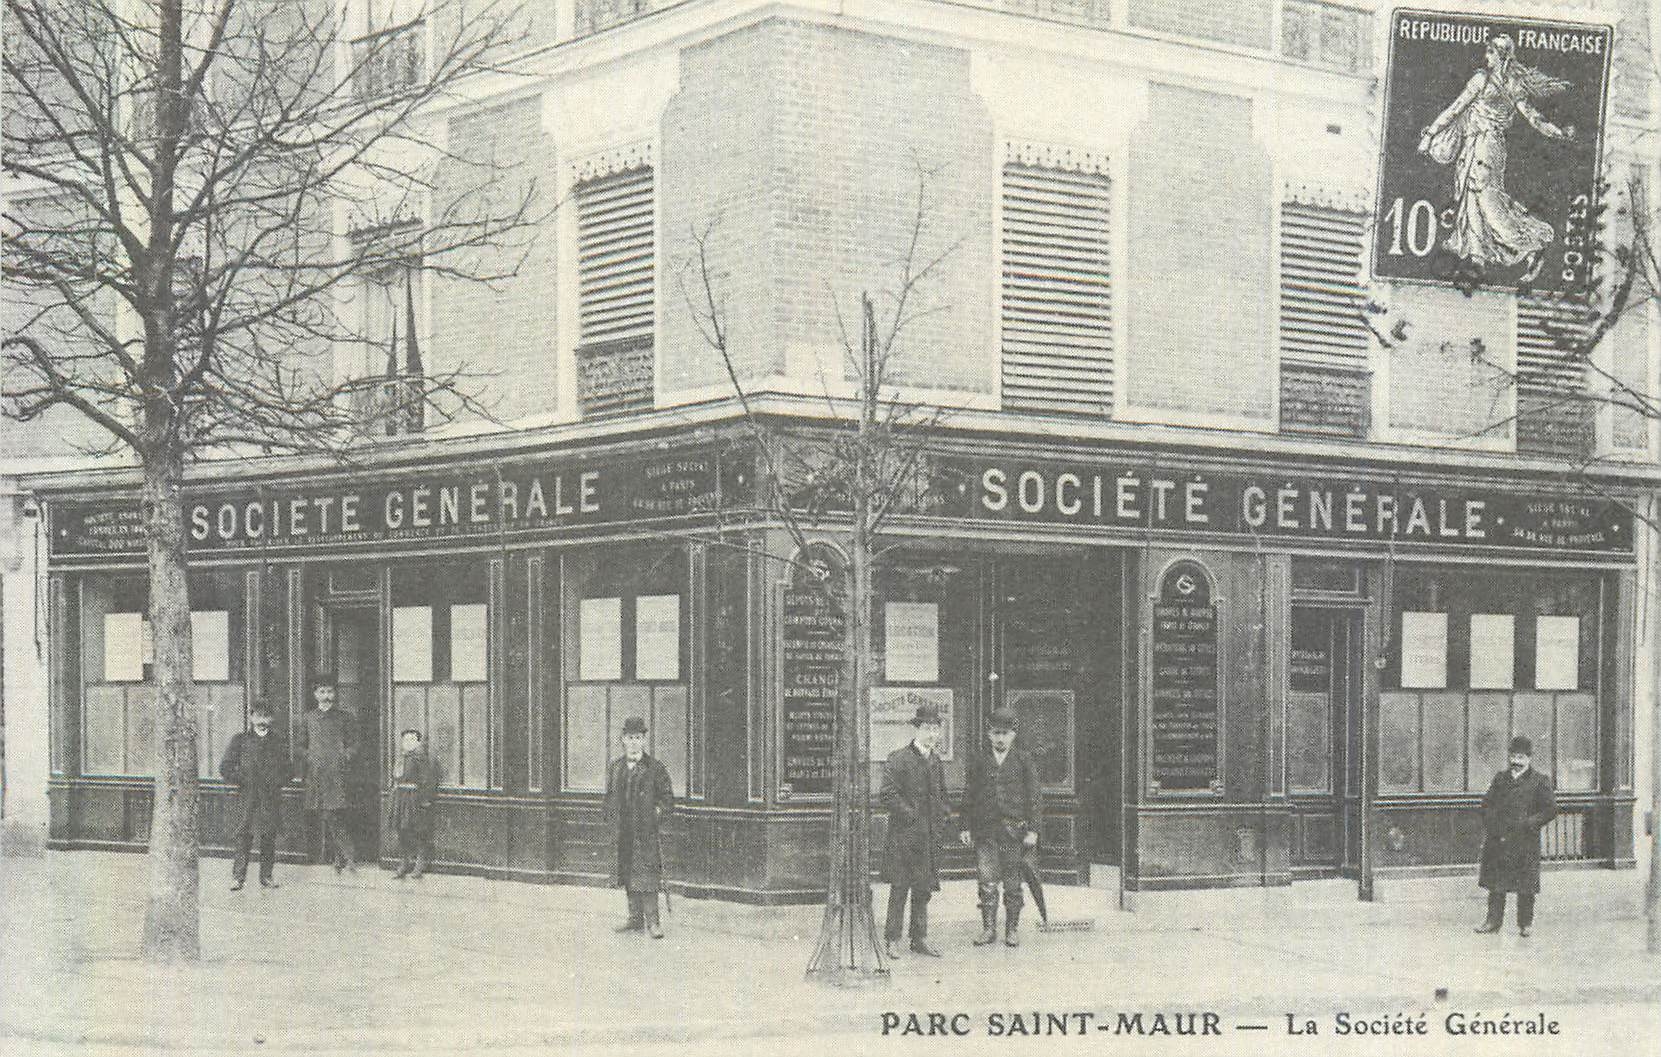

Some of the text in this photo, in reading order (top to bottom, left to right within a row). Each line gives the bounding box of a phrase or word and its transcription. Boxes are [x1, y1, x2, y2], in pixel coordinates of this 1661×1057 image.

[385, 472, 600, 529] GÉNÉRALE
[981, 469, 1486, 538] SOCIÉTÉ GÉNÉRALE
